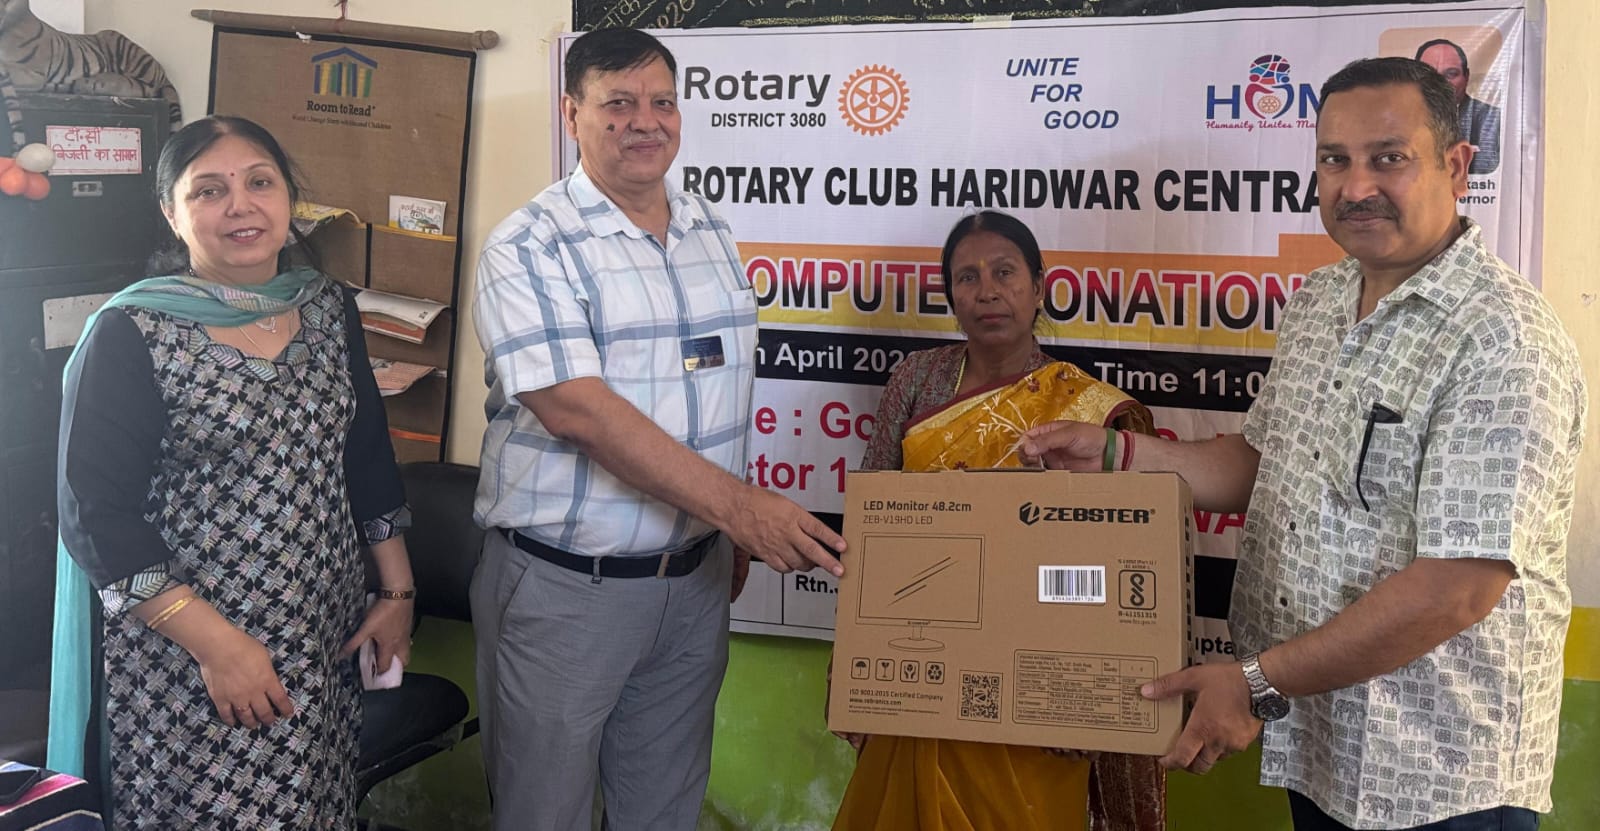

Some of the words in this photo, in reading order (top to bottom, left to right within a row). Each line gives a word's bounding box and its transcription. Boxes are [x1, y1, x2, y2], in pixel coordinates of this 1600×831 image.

[1006, 58, 1079, 77] UNITE
[684, 66, 831, 108] Rotary
[1030, 84, 1082, 103] FOR
[306, 101, 338, 113] Room
[340, 104, 348, 114] to
[348, 105, 372, 117] Read
[711, 113, 785, 128] DISTRICT
[790, 113, 826, 128] 3080
[1044, 110, 1119, 129] GOOD
[1205, 121, 1254, 132] Humanity
[1296, 120, 1319, 128] Ma
[94, 149, 110, 161] का
[683, 166, 814, 204] ROTARY
[824, 167, 918, 206] CLUB
[931, 168, 1141, 210] HARIDWAR
[1154, 169, 1320, 213] CENTRA
[1459, 195, 1496, 204] ernor
[746, 258, 949, 315] OMPUTE
[1043, 268, 1302, 330] ONATION
[774, 343, 843, 373] April
[853, 348, 903, 374] 202
[1094, 361, 1178, 393] Time
[1192, 367, 1265, 398] 11:0
[820, 402, 876, 441] Go
[863, 500, 883, 511] LED
[887, 500, 929, 511] Monitor
[932, 501, 972, 512] 48.2cm
[915, 515, 933, 525] LED
[849, 688, 860, 696] ISO
